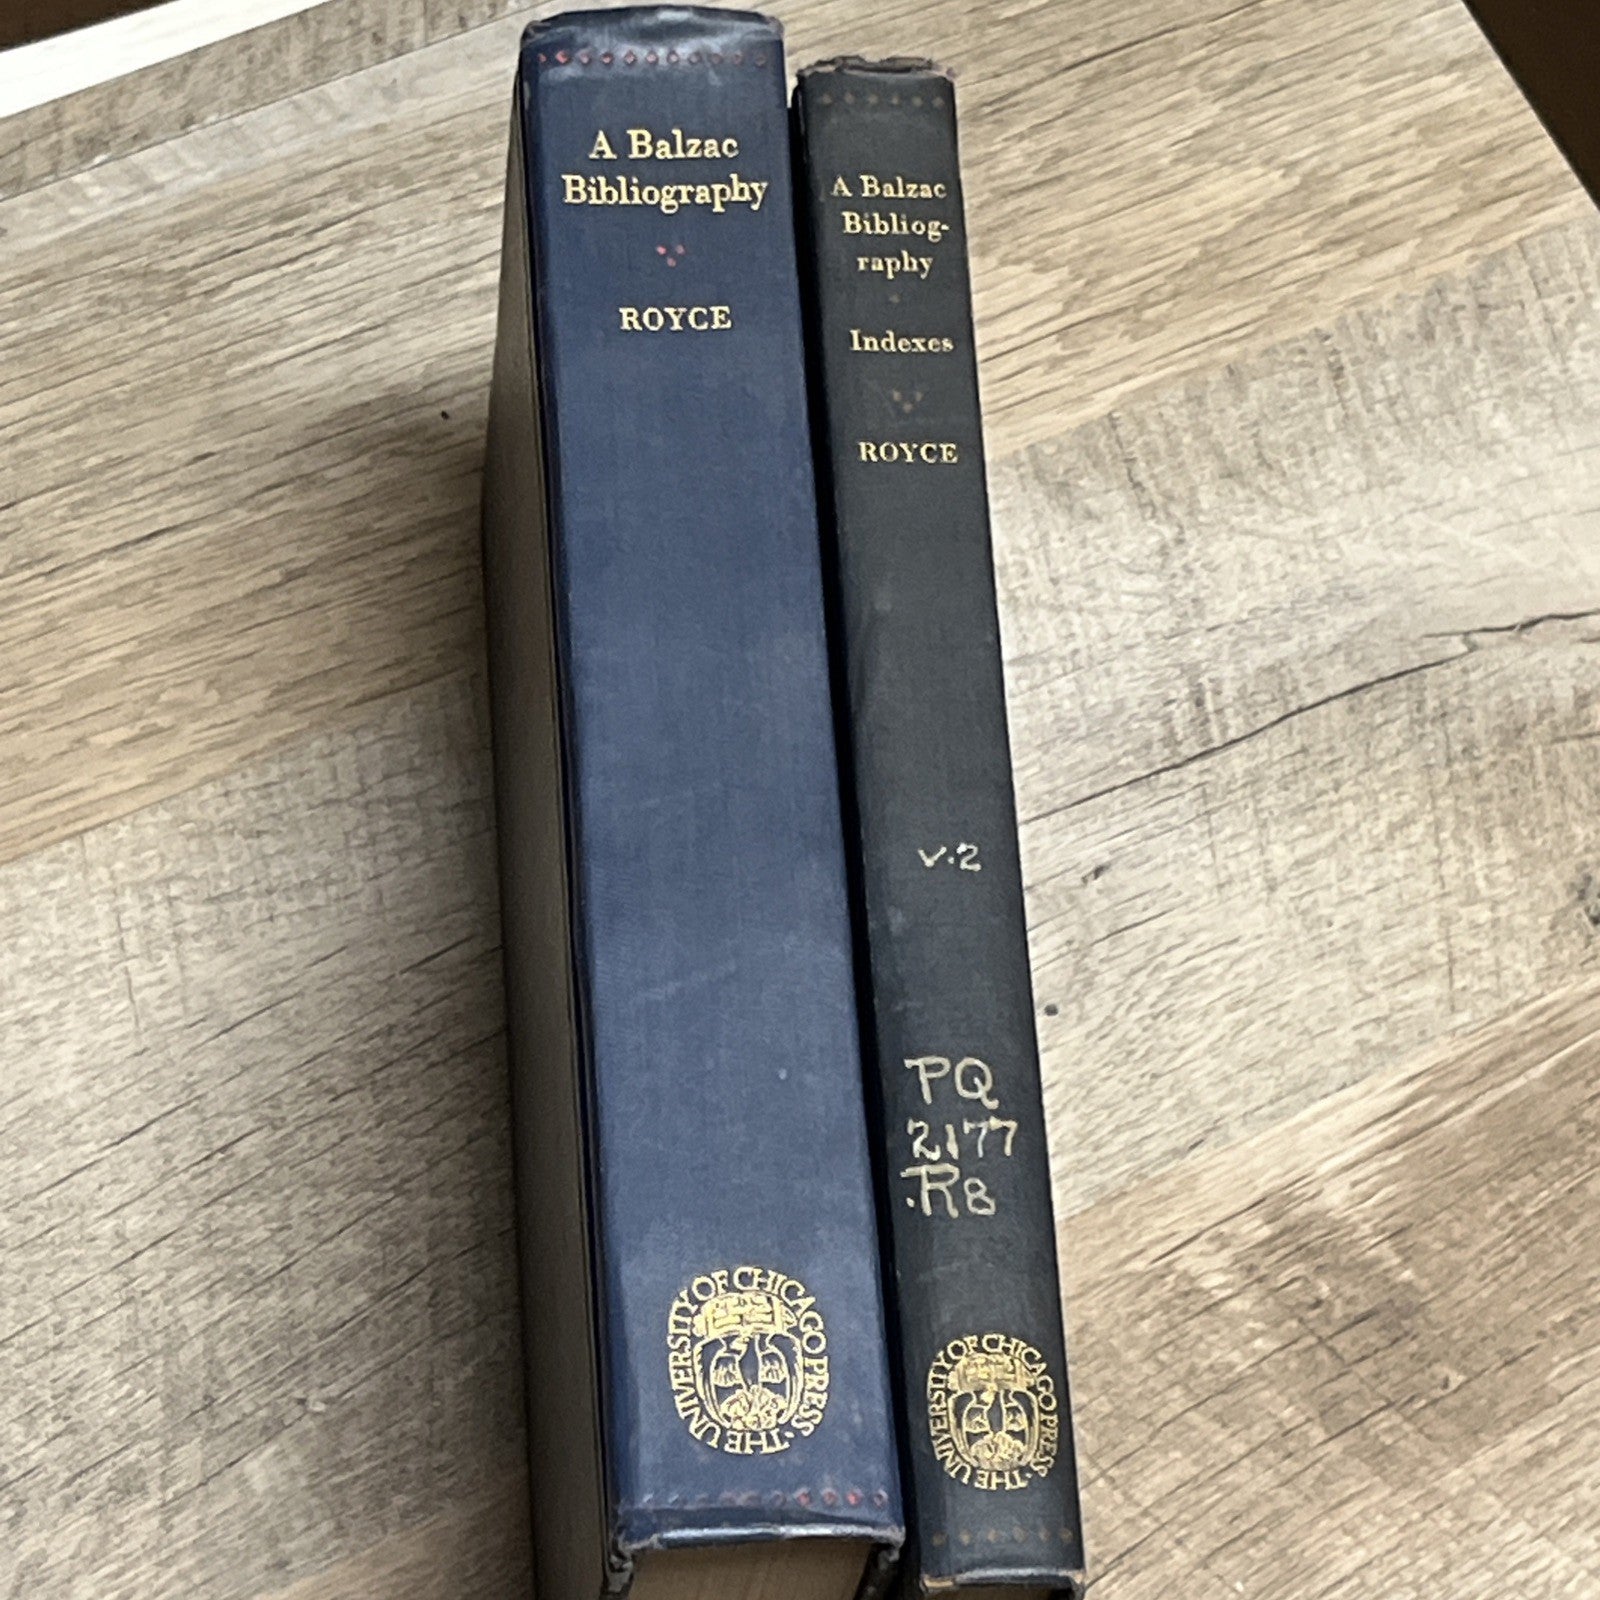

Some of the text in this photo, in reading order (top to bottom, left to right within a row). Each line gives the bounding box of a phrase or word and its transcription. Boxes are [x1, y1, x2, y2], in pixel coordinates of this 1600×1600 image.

[588, 128, 740, 160] A Balzac
[560, 174, 769, 214] Bibliography
[830, 174, 948, 200] A Balzac
[841, 211, 951, 242] Bibliog-
[856, 250, 934, 279] raphy
[618, 305, 733, 332] ROYCE
[849, 329, 955, 354] Indexes
[858, 441, 959, 465] ROYCE
[904, 1056, 999, 1109] PQ
[907, 1115, 1018, 1161] 2177
[900, 1163, 996, 1218] .R8
[667, 1266, 830, 1455] THE UNIVERSITY OF CHICAGO PRESS
[926, 1333, 1059, 1491] THE UNIVERSITY OF CHICAGO PRESS
